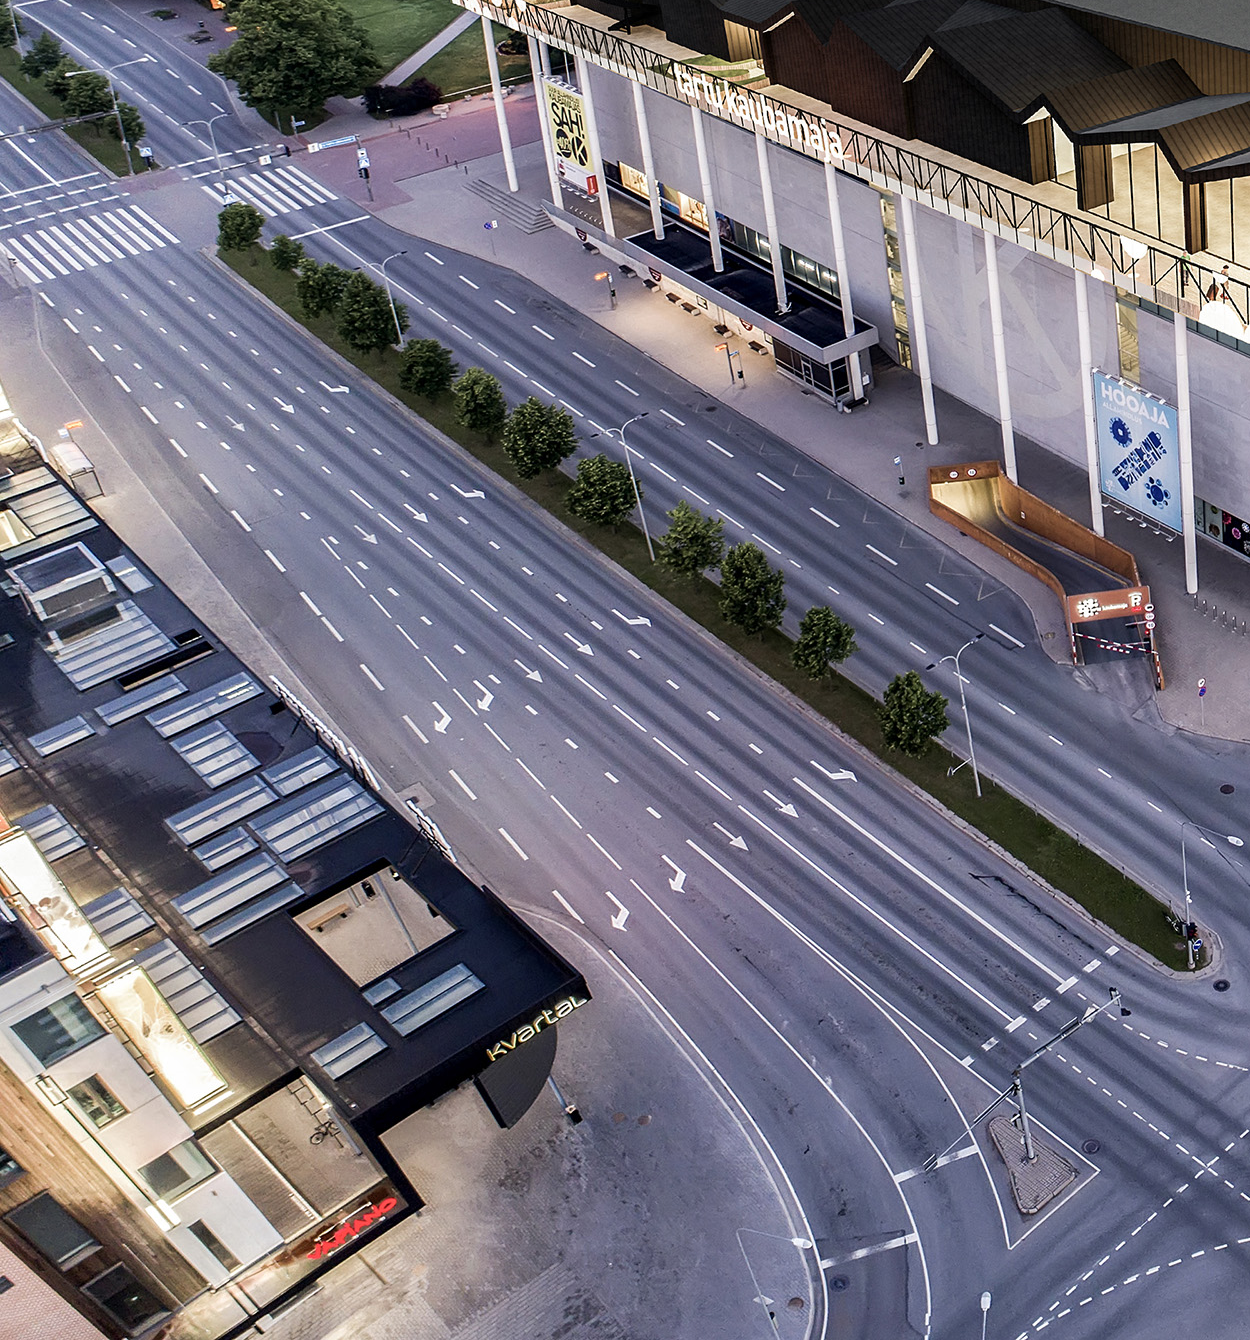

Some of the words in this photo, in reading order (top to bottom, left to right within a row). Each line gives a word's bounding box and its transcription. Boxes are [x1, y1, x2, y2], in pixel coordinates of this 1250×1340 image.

[551, 102, 585, 139] SAH!
[673, 61, 724, 110] tartu
[723, 80, 846, 163] kaubamaja
[1101, 381, 1170, 429] HOOAJA
